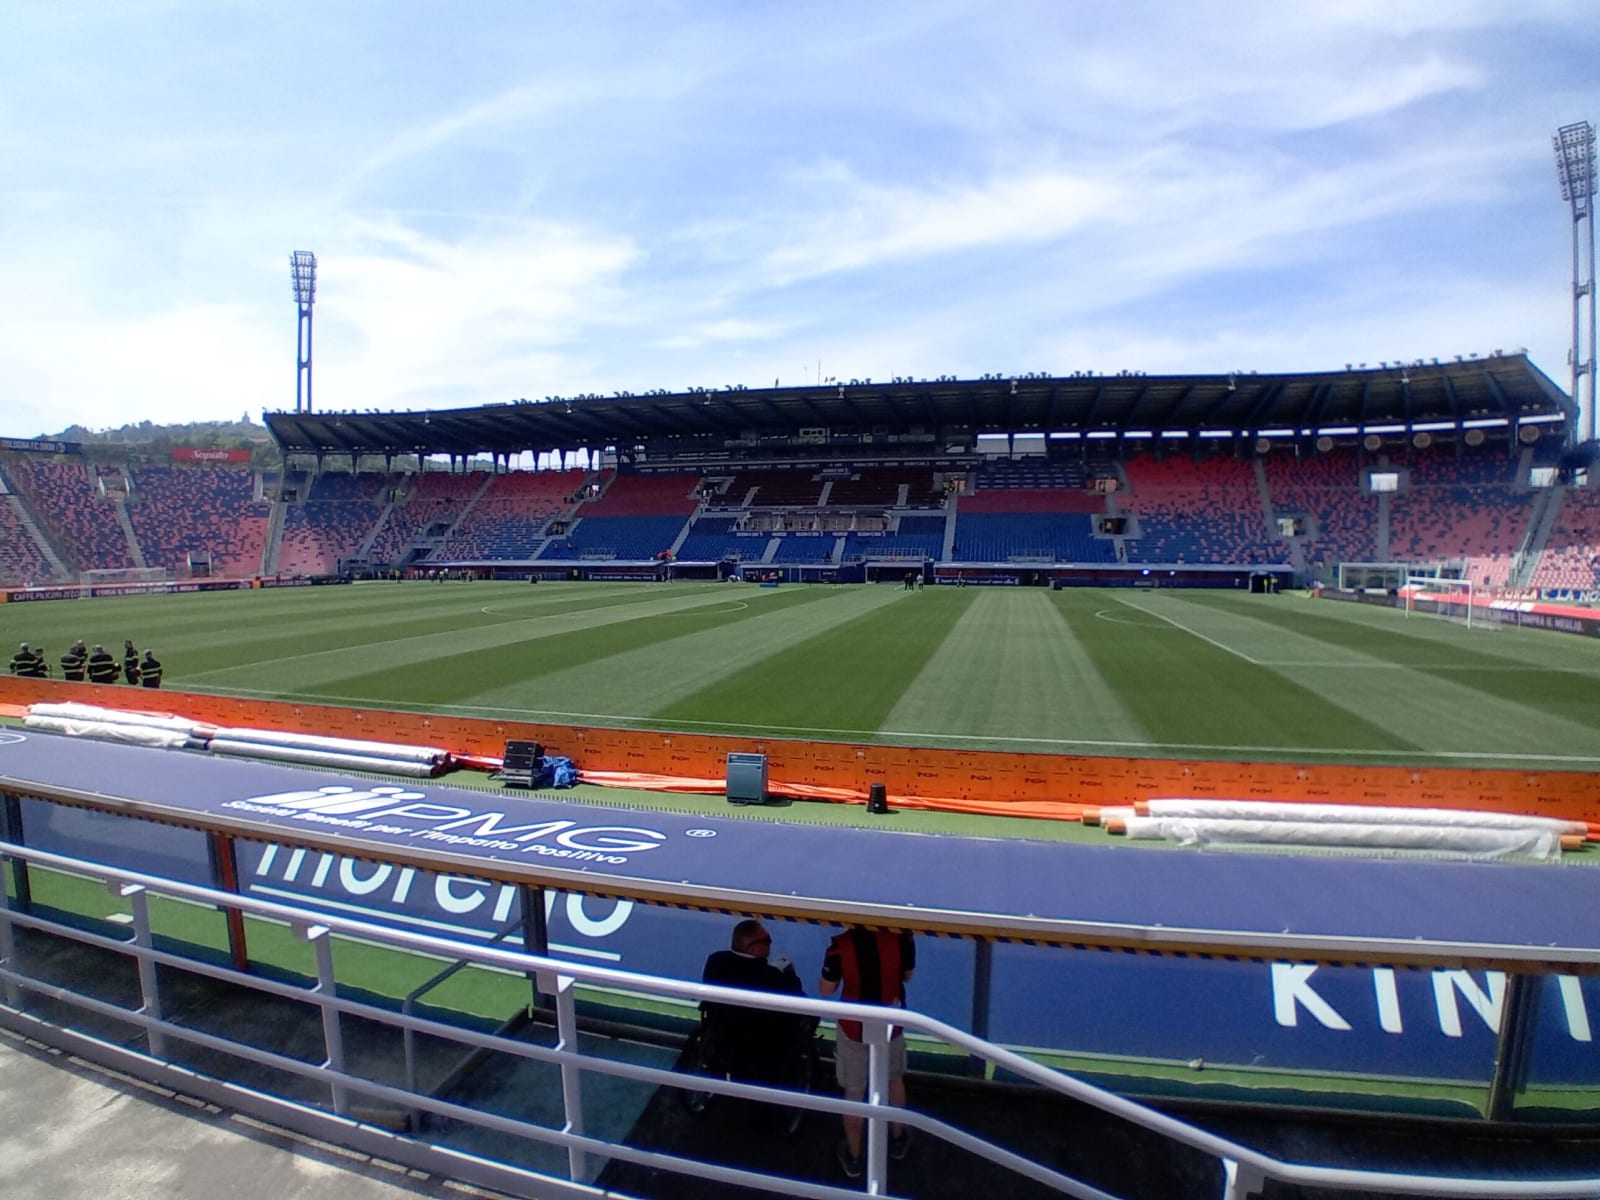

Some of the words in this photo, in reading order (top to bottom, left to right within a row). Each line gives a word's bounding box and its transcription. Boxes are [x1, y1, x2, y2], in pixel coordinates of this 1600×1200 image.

[355, 803, 667, 852] PMG
[362, 824, 413, 834] per
[521, 844, 637, 864] Positivo
